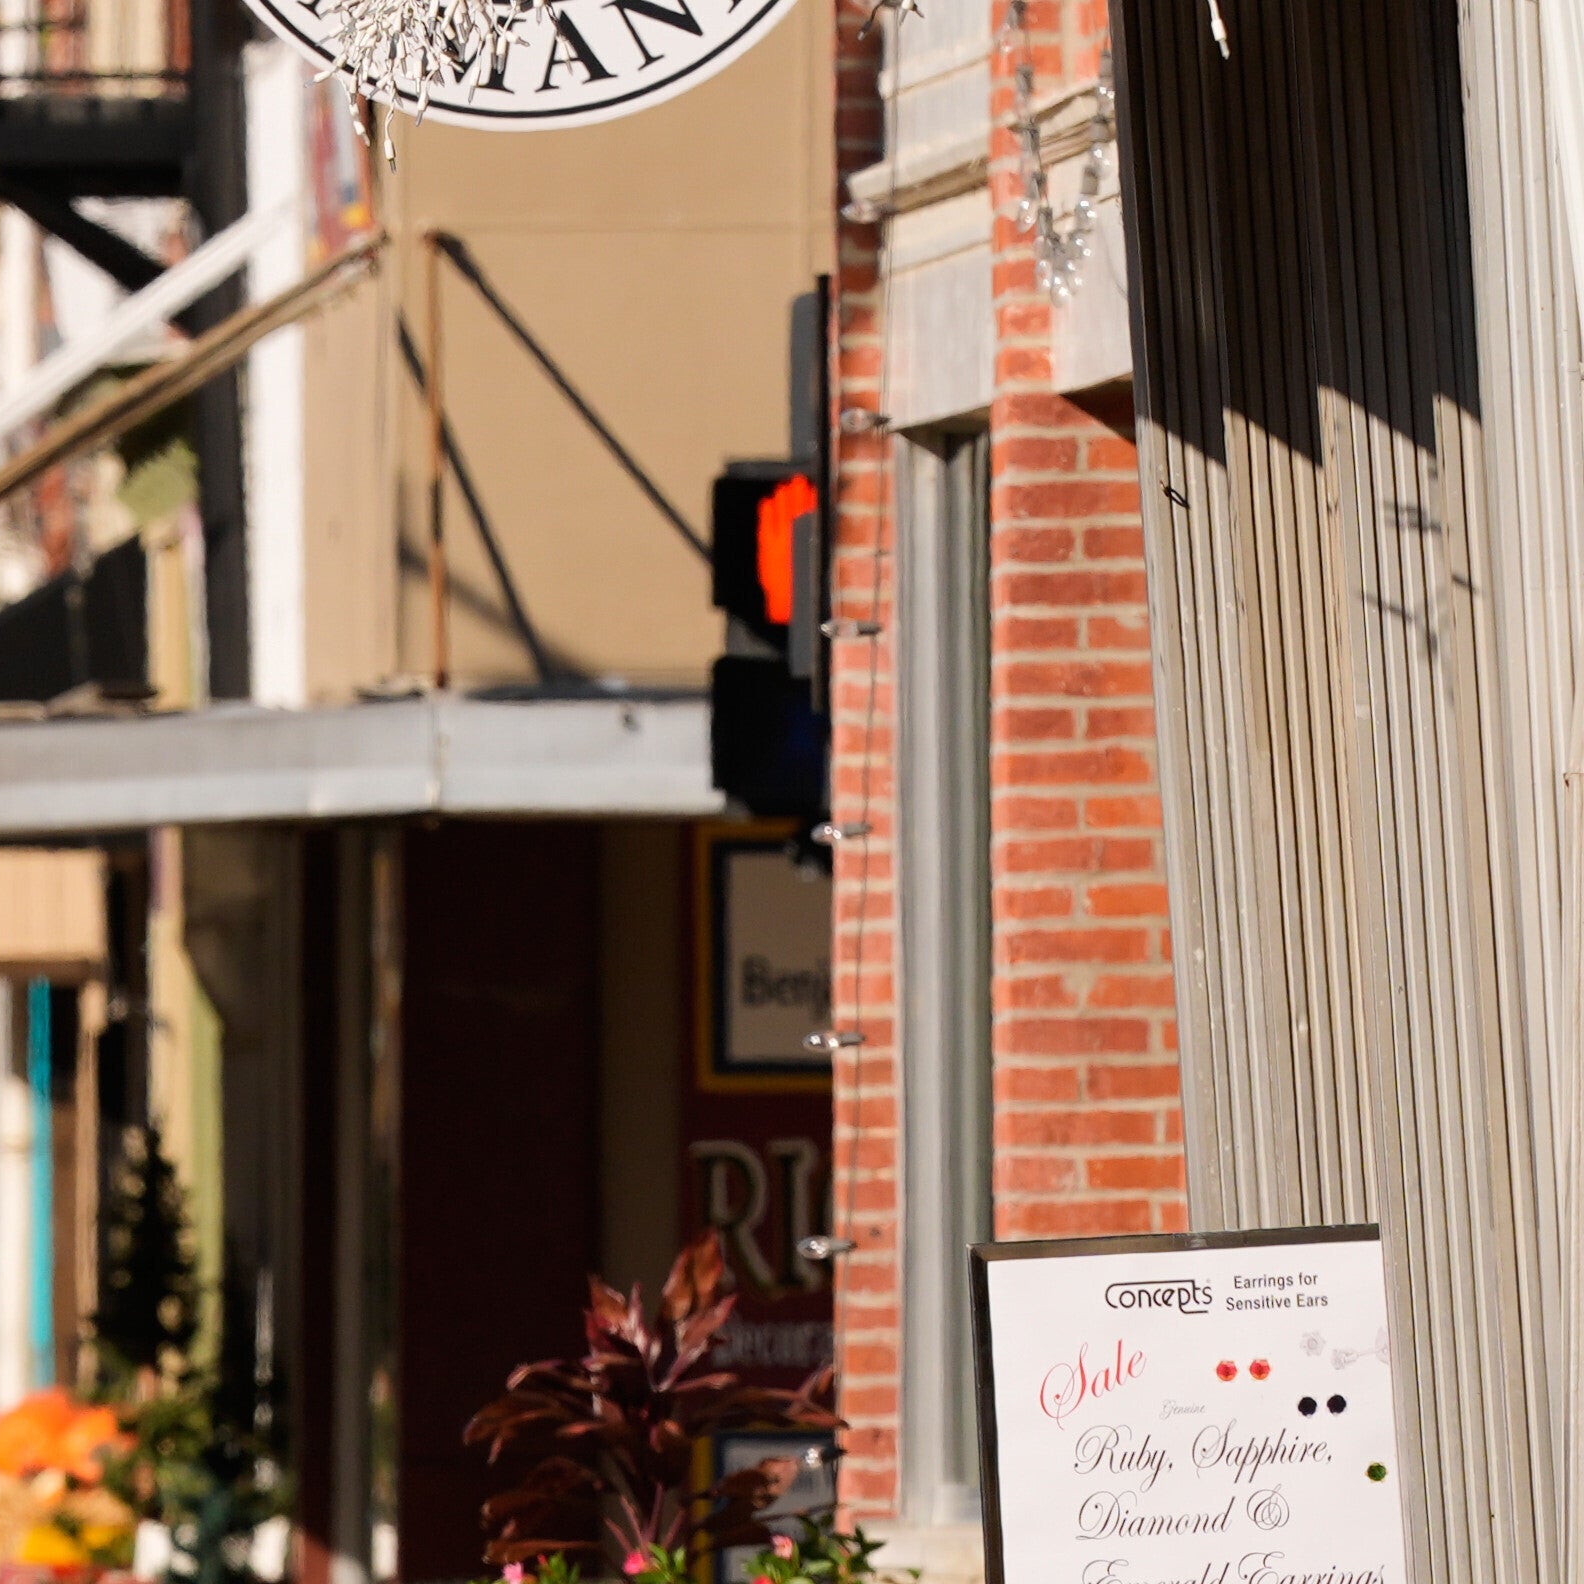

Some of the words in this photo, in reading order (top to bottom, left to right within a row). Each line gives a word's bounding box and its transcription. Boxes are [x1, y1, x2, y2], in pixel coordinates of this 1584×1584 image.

[742, 953, 833, 1022] Benj
[688, 1136, 834, 1296] RI
[1104, 1279, 1213, 1314] Concepts
[1225, 1296, 1292, 1311] Sensitive
[1296, 1293, 1329, 1308] Ears
[1233, 1274, 1294, 1291] Earrings
[1298, 1272, 1318, 1287] for
[1039, 1338, 1147, 1430] Sale
[1074, 1424, 1173, 1493] Ruby,
[1192, 1418, 1332, 1484] Sapphire,
[1075, 1490, 1236, 1540] Diamond
[1246, 1484, 1290, 1531] &
